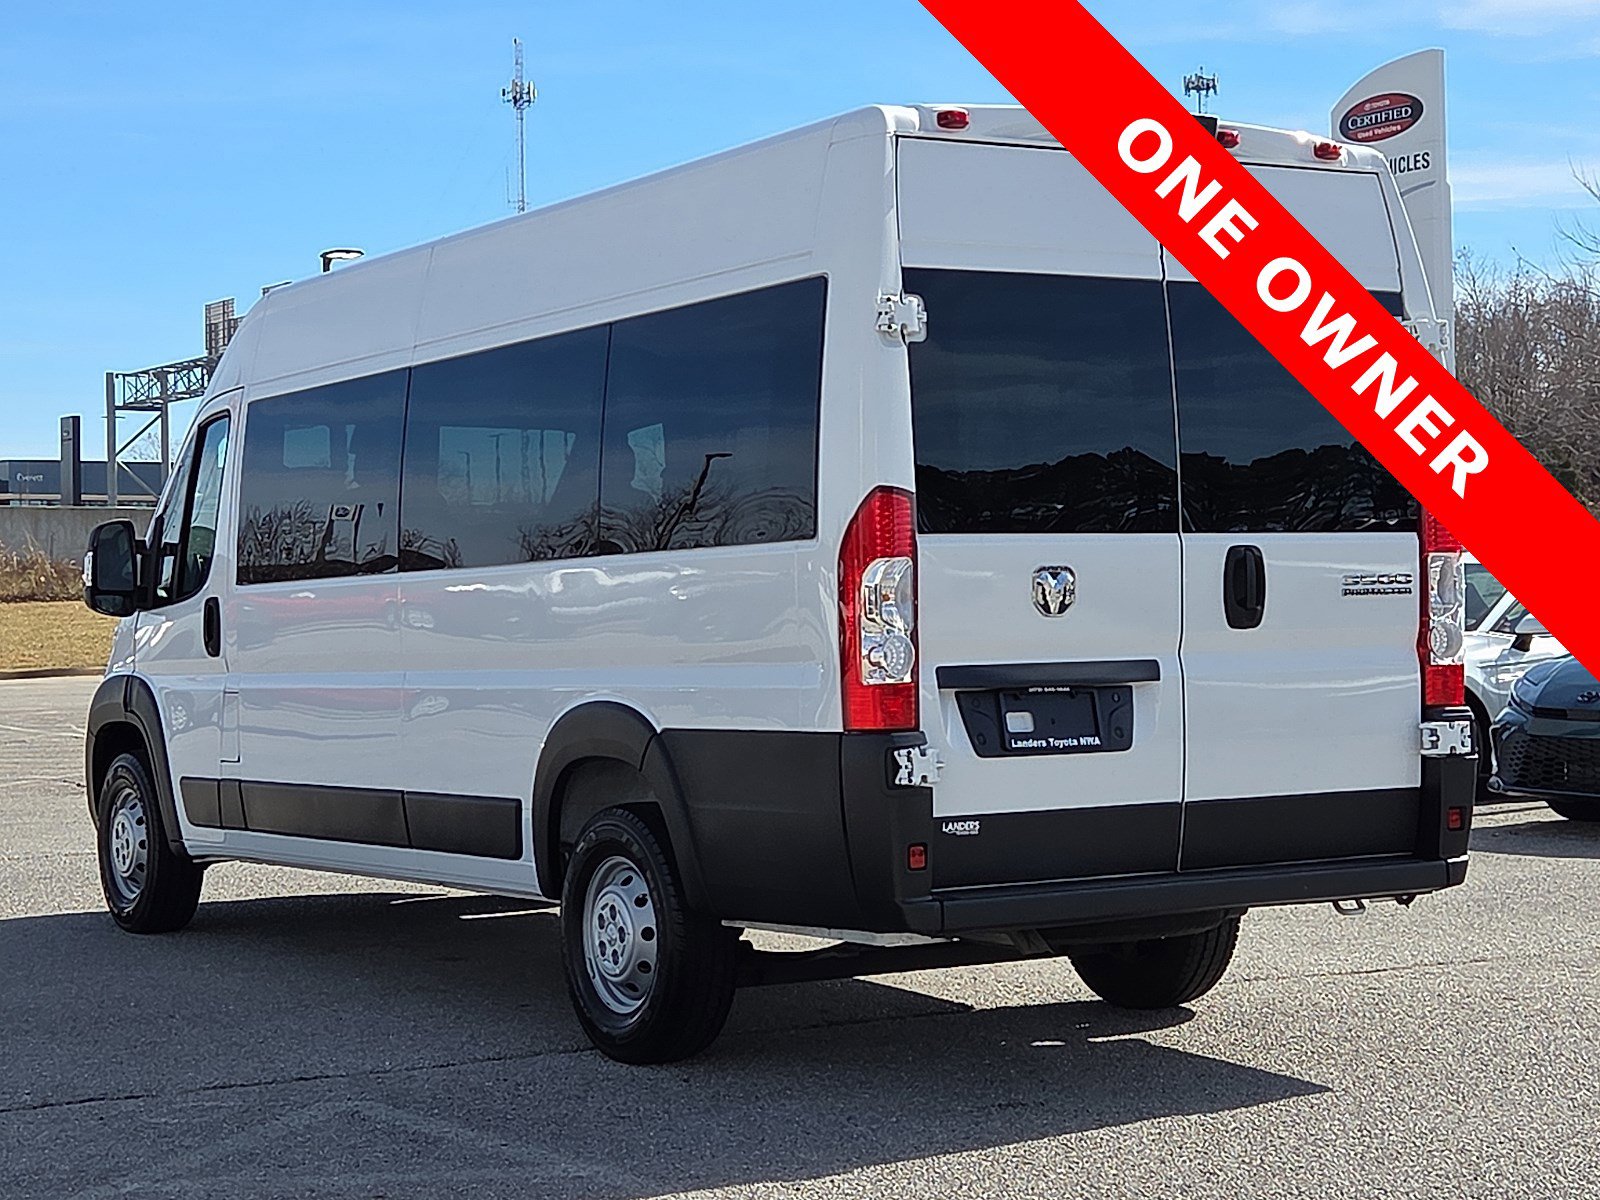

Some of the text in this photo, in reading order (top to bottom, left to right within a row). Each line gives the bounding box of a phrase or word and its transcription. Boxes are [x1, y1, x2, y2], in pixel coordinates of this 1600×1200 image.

[1348, 106, 1412, 130] CERTIFIED
[1357, 124, 1402, 139] Used Vehicles
[1011, 738, 1047, 748] Landers
[1047, 737, 1078, 749] Toyota
[942, 820, 980, 833] LANDERS
